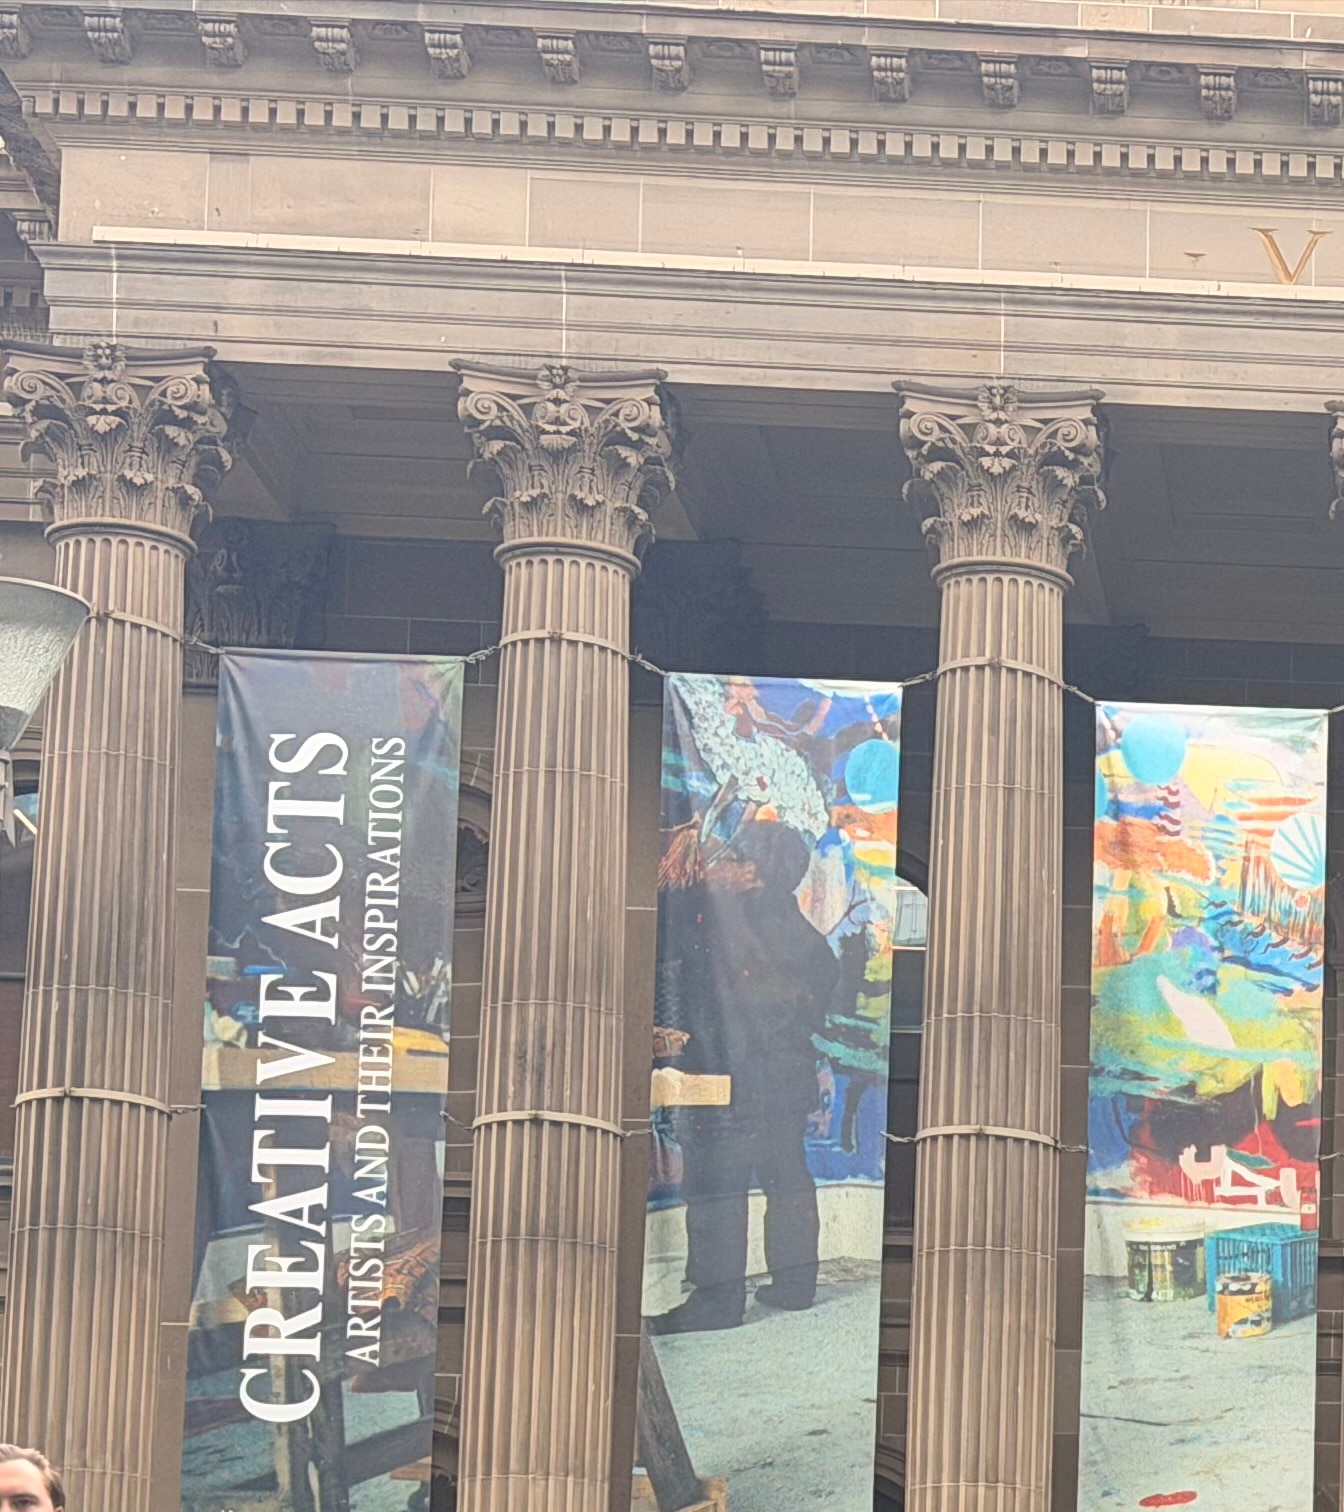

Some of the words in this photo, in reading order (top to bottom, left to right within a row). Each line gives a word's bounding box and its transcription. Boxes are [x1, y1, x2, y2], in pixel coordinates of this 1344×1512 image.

[260, 731, 349, 950] ACTS
[361, 736, 406, 993] INSPIRATIONS
[356, 1004, 396, 1119] THEIR
[239, 969, 338, 1424] CREATIVE
[351, 1124, 390, 1209] AND
[345, 1213, 388, 1368] ARTISTS
